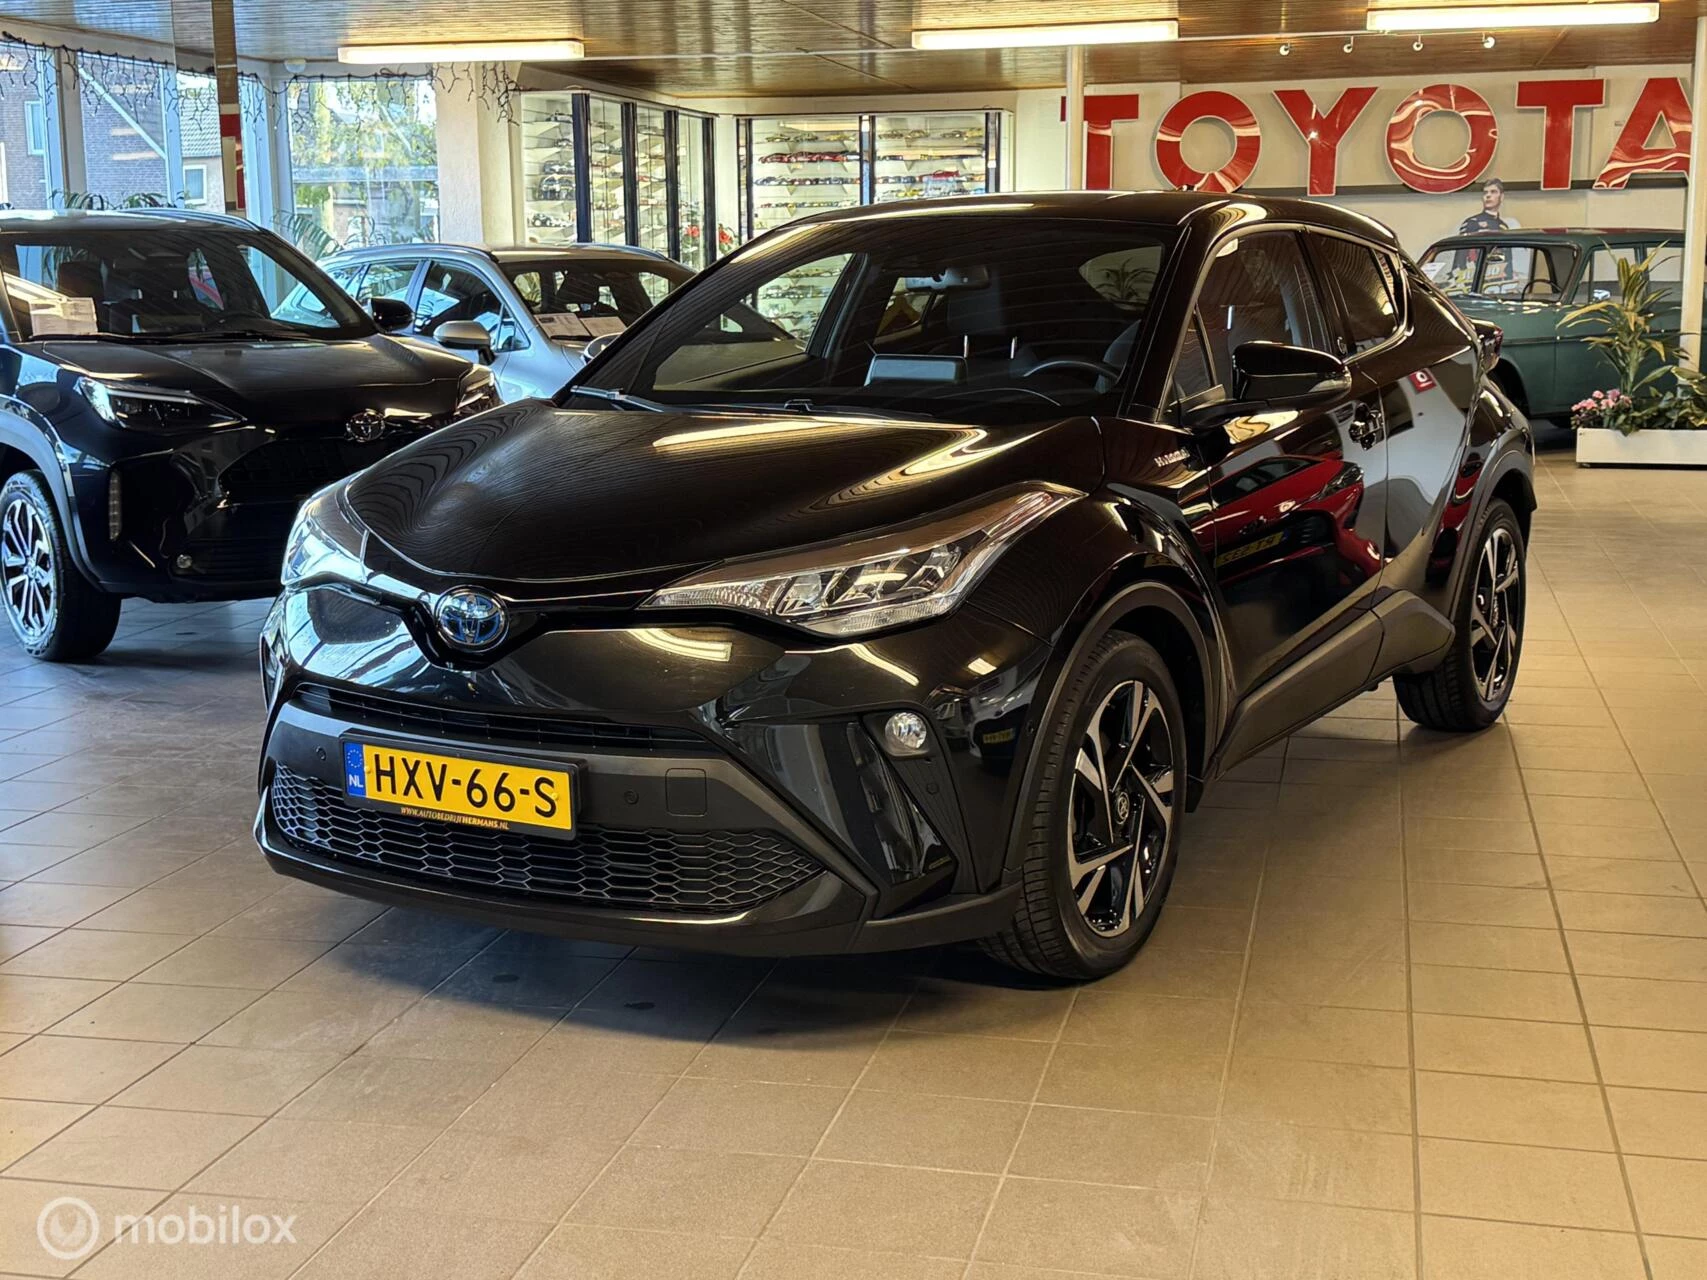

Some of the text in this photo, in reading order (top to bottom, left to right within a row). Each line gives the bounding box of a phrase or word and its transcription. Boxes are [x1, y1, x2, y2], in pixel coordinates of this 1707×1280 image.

[1061, 77, 1692, 196] TOYOTA
[348, 774, 364, 788] NL
[374, 753, 557, 819] HXV-66-S
